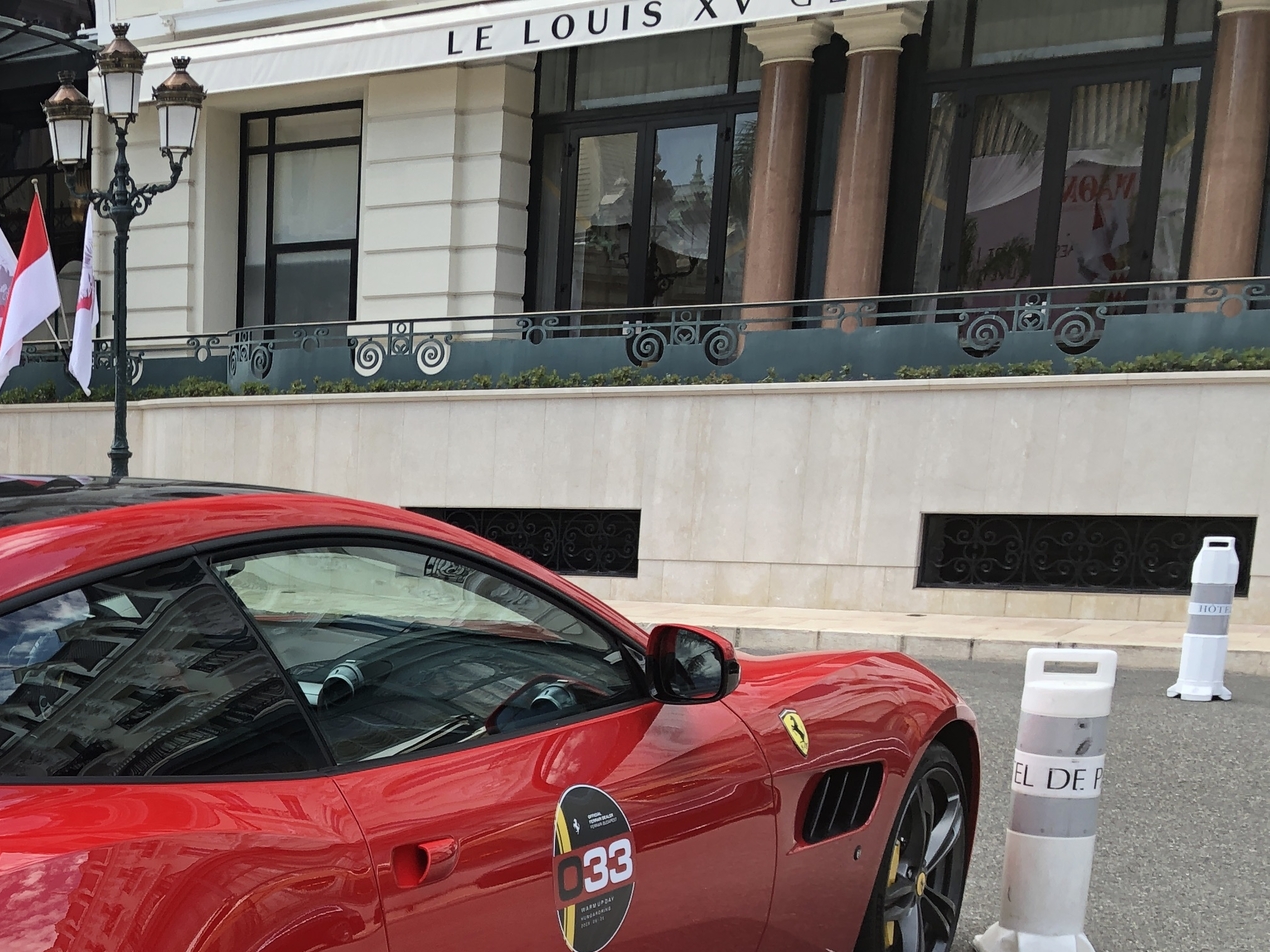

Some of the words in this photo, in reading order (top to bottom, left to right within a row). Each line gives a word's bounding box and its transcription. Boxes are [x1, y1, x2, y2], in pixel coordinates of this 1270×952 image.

[447, 25, 493, 55] LE
[523, 0, 662, 45] LOUIS
[694, 0, 752, 21] XV
[1047, 767, 1087, 790] DE
[558, 838, 633, 902] 033
